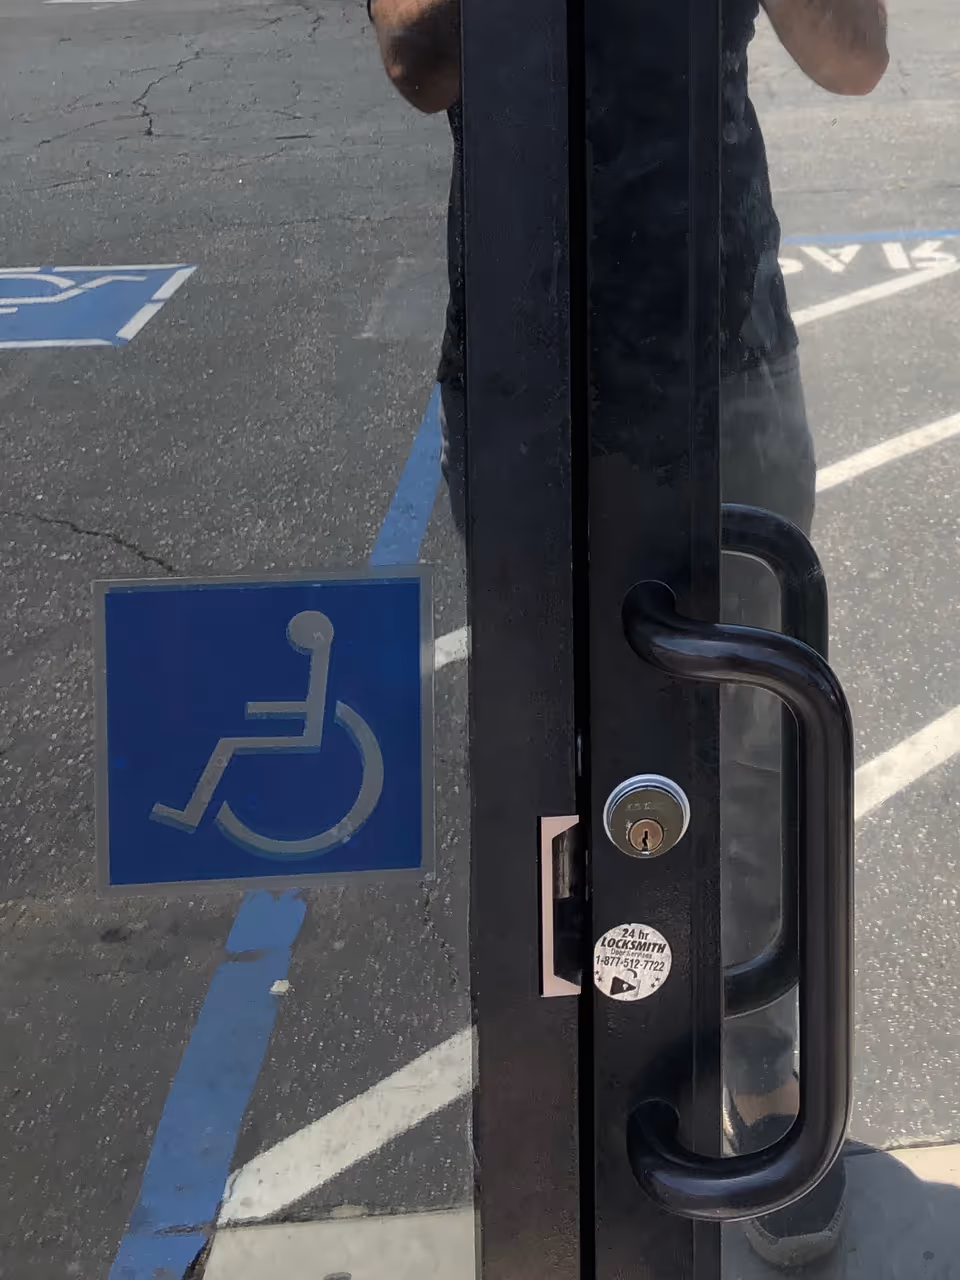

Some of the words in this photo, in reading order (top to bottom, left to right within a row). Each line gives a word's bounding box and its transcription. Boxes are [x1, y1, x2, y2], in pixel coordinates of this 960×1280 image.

[622, 928, 635, 939] 24
[638, 930, 649, 940] hr
[601, 937, 667, 954] LOCKSMITH
[596, 955, 665, 972] 1-877-512-7722
